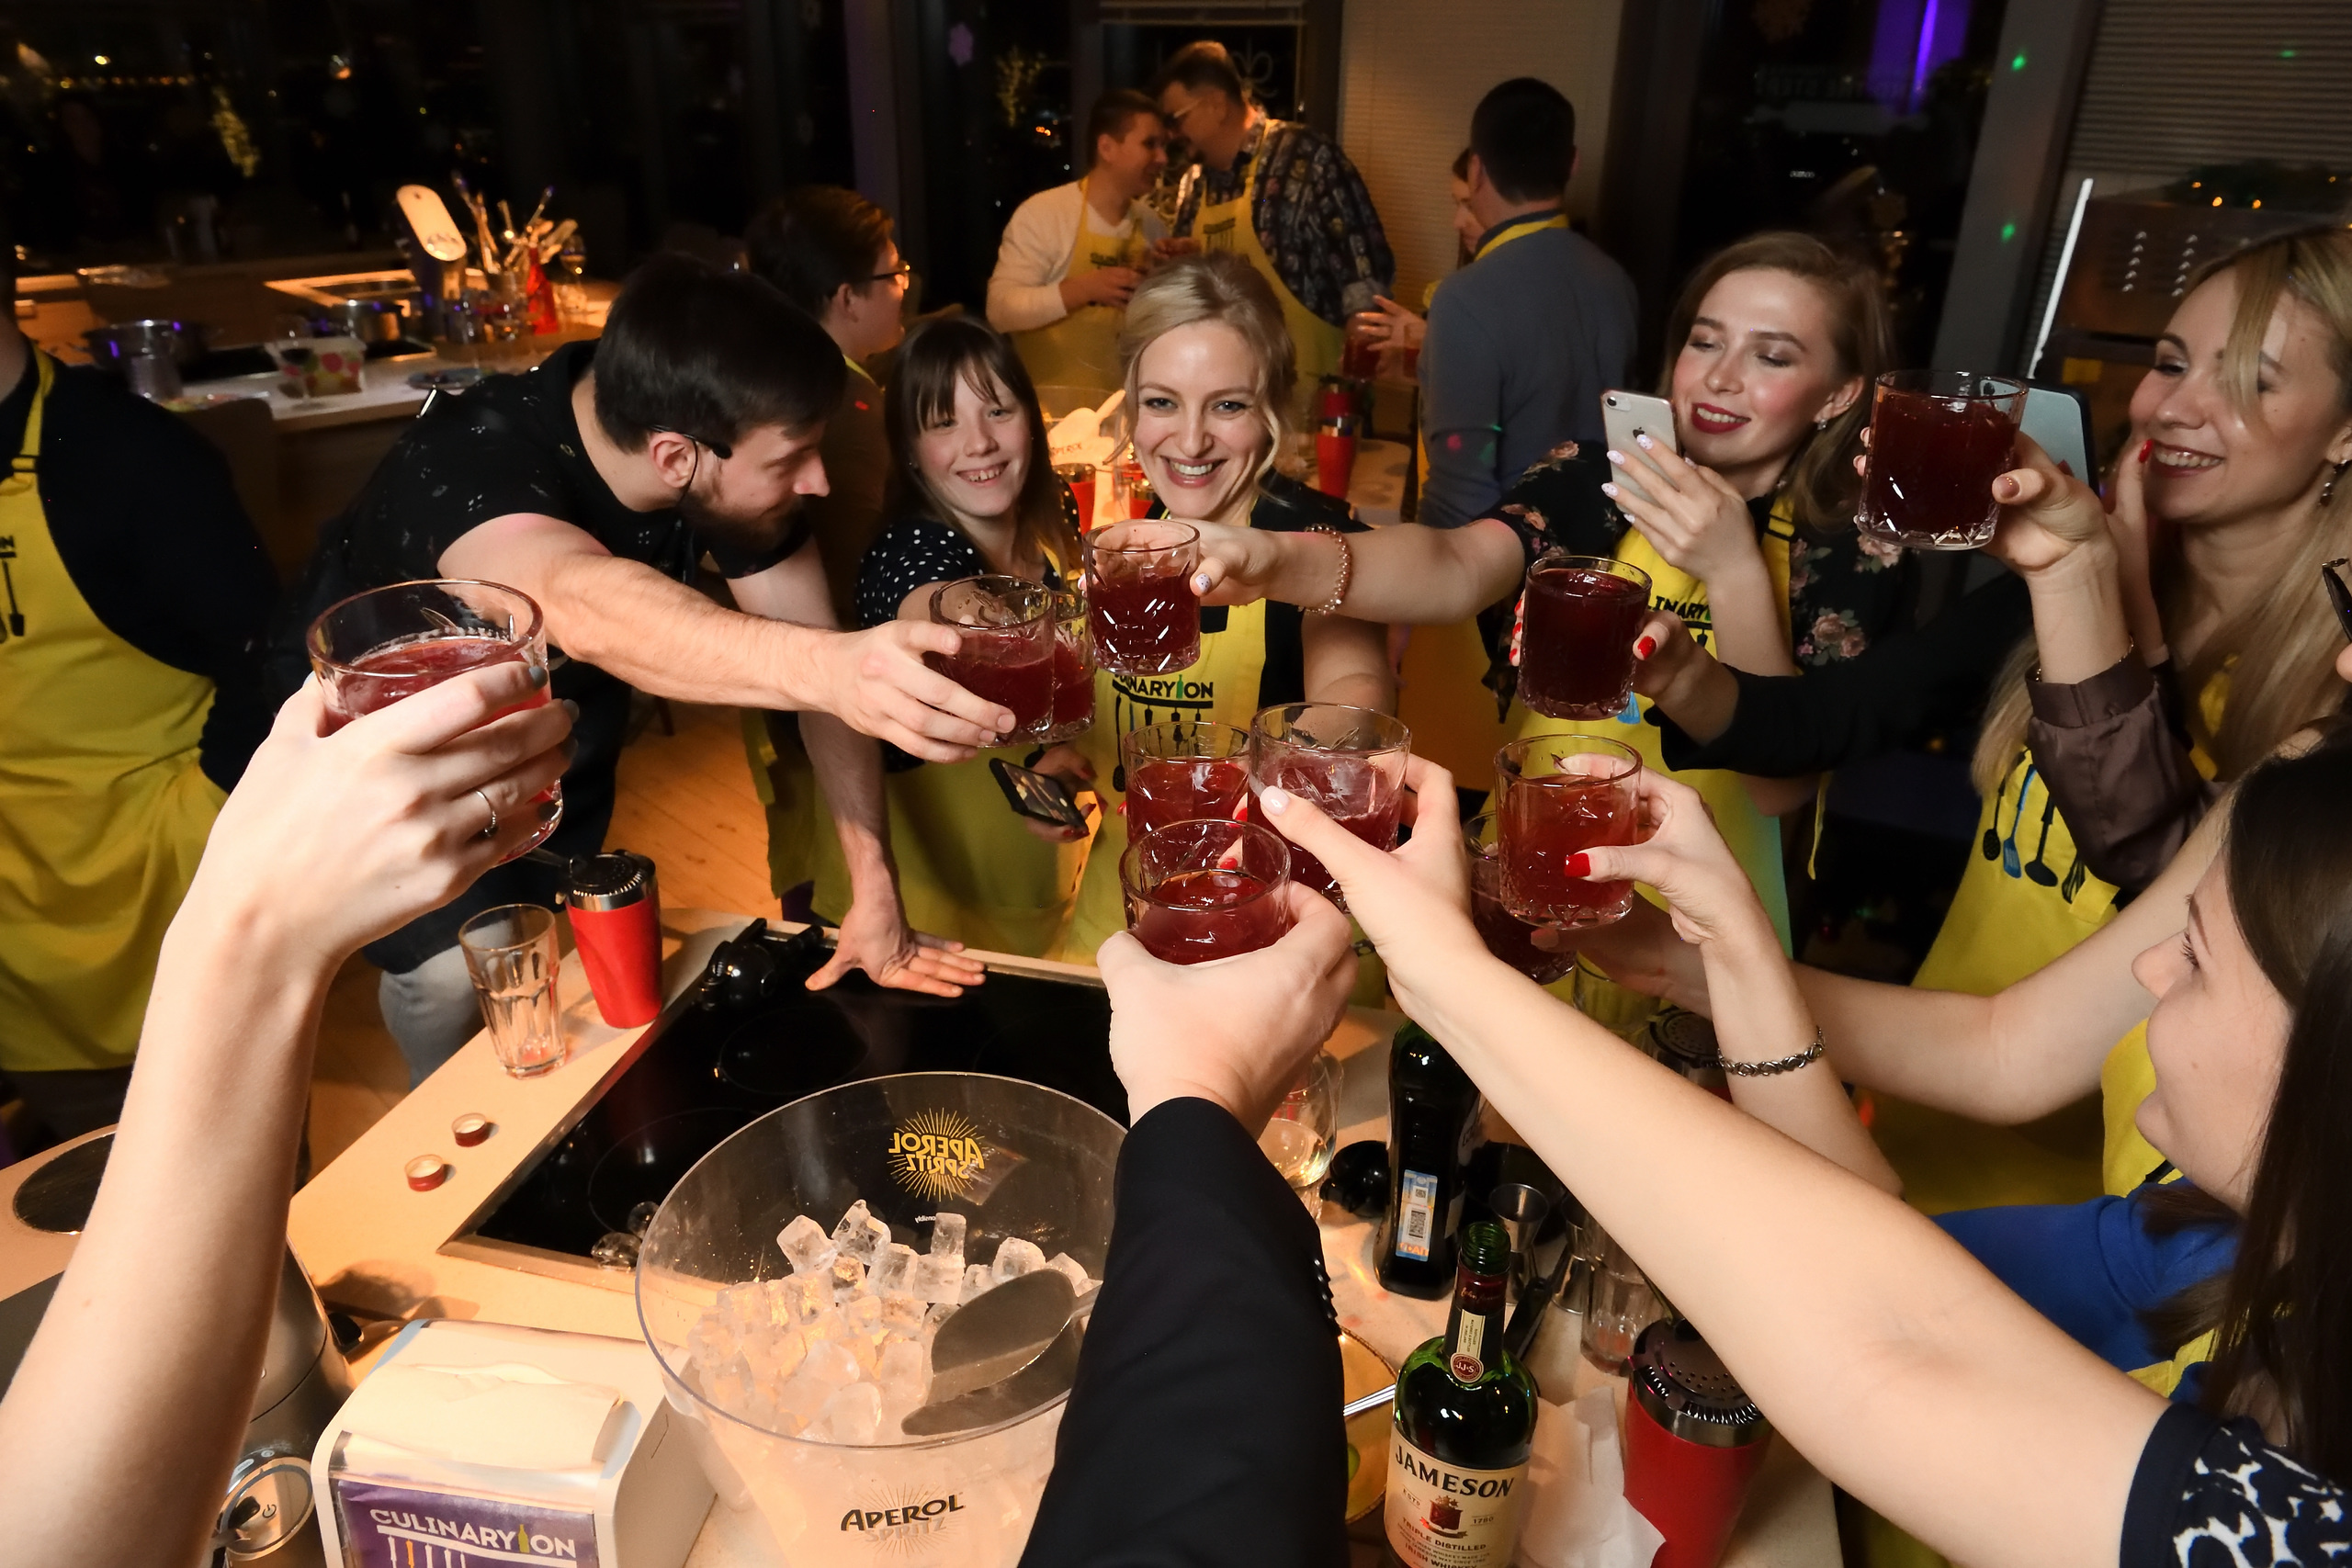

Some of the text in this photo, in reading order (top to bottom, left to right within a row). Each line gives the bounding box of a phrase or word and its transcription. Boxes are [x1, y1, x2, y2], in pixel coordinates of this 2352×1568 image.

[1396, 1444, 1515, 1498] JAMESON
[841, 1494, 966, 1531] APEROL
[1403, 1517, 1432, 1543] TRIPLE
[1435, 1540, 1487, 1551] DISTILLED
[1406, 1542, 1429, 1562] IRISH
